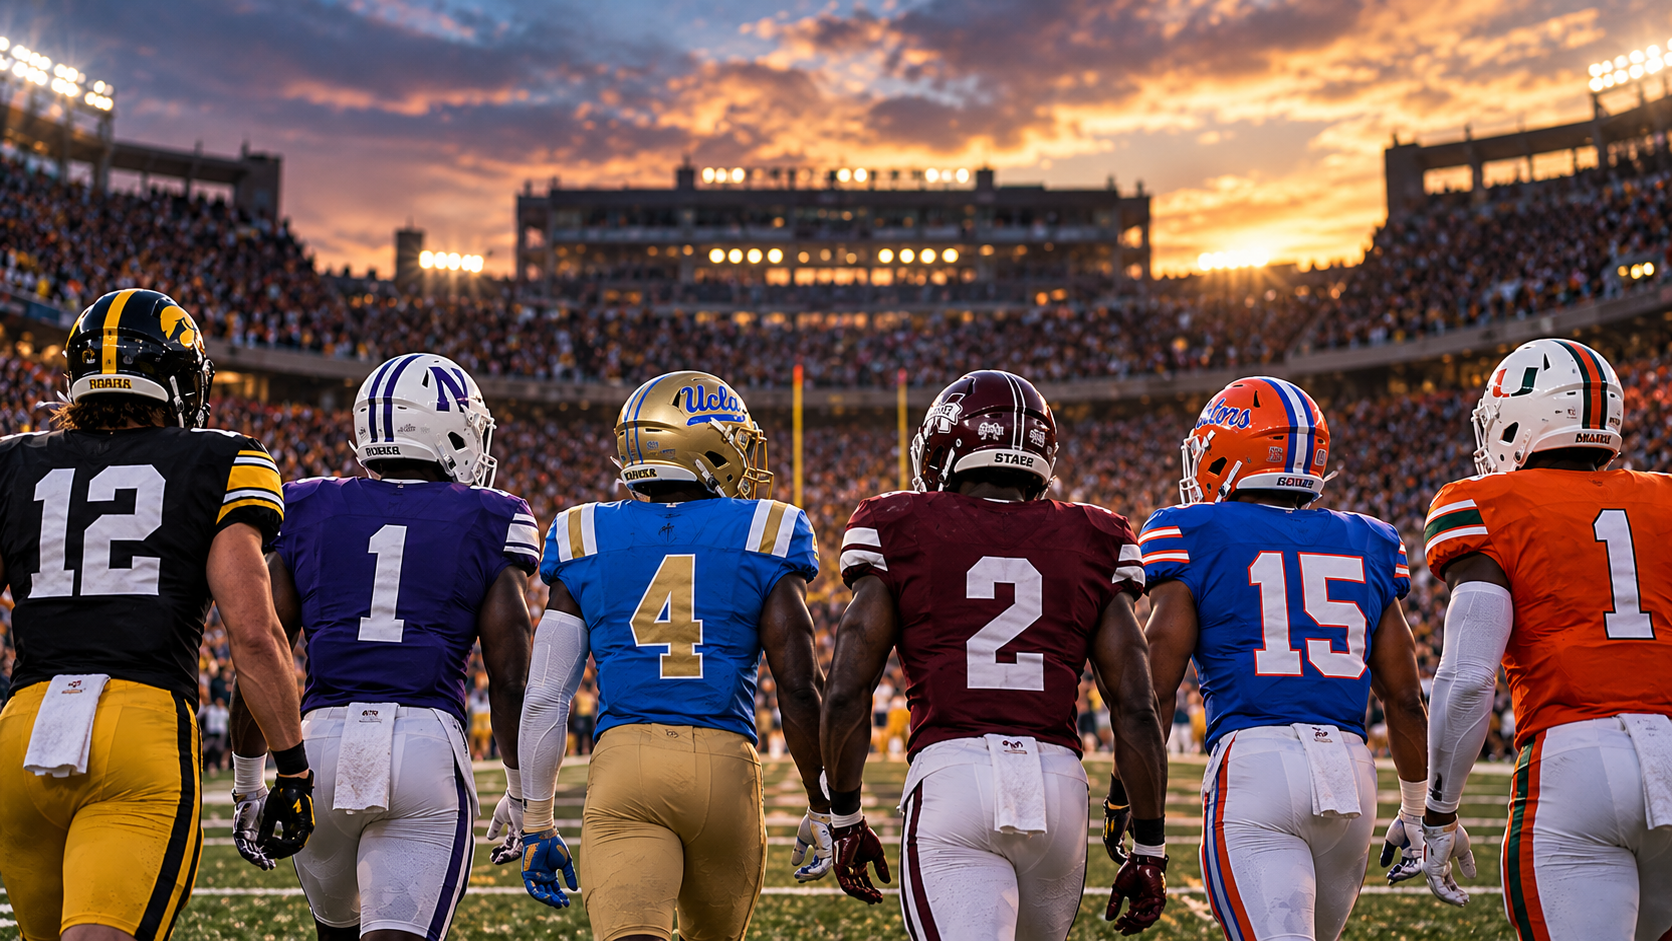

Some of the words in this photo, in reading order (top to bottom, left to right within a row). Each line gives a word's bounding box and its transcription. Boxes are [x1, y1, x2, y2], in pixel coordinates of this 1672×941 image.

[428, 366, 469, 413] N
[1492, 367, 1539, 398] U
[27, 464, 167, 599] 12
[358, 524, 408, 643] 1
[1592, 508, 1657, 640] 1
[629, 553, 704, 680] 4
[966, 555, 1044, 692] 2
[1247, 550, 1368, 680] 15
